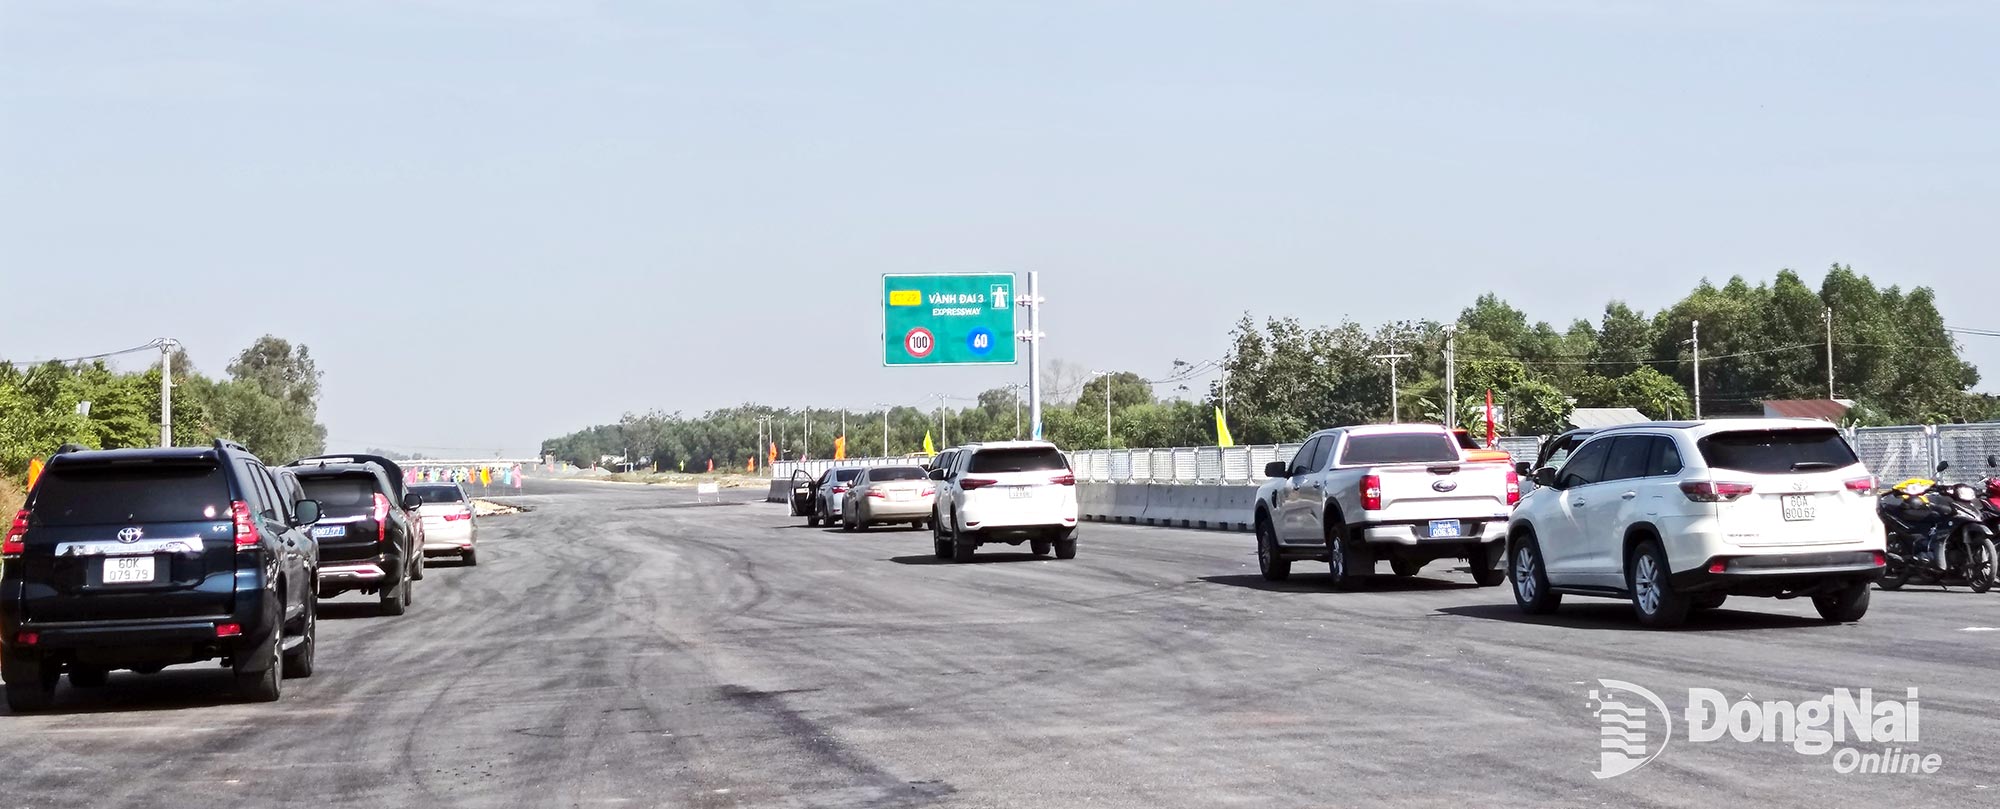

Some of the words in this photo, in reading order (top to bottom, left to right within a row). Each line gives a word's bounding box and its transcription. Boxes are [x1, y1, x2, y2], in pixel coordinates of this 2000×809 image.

[928, 292, 956, 304] VÀNH
[958, 293, 976, 304] ĐAI
[977, 294, 985, 303] 3
[932, 307, 981, 316] EXPRESSWAY
[912, 335, 928, 349] 100
[973, 333, 988, 348] 60
[1790, 495, 1808, 507] 60A
[118, 558, 139, 569] 60K
